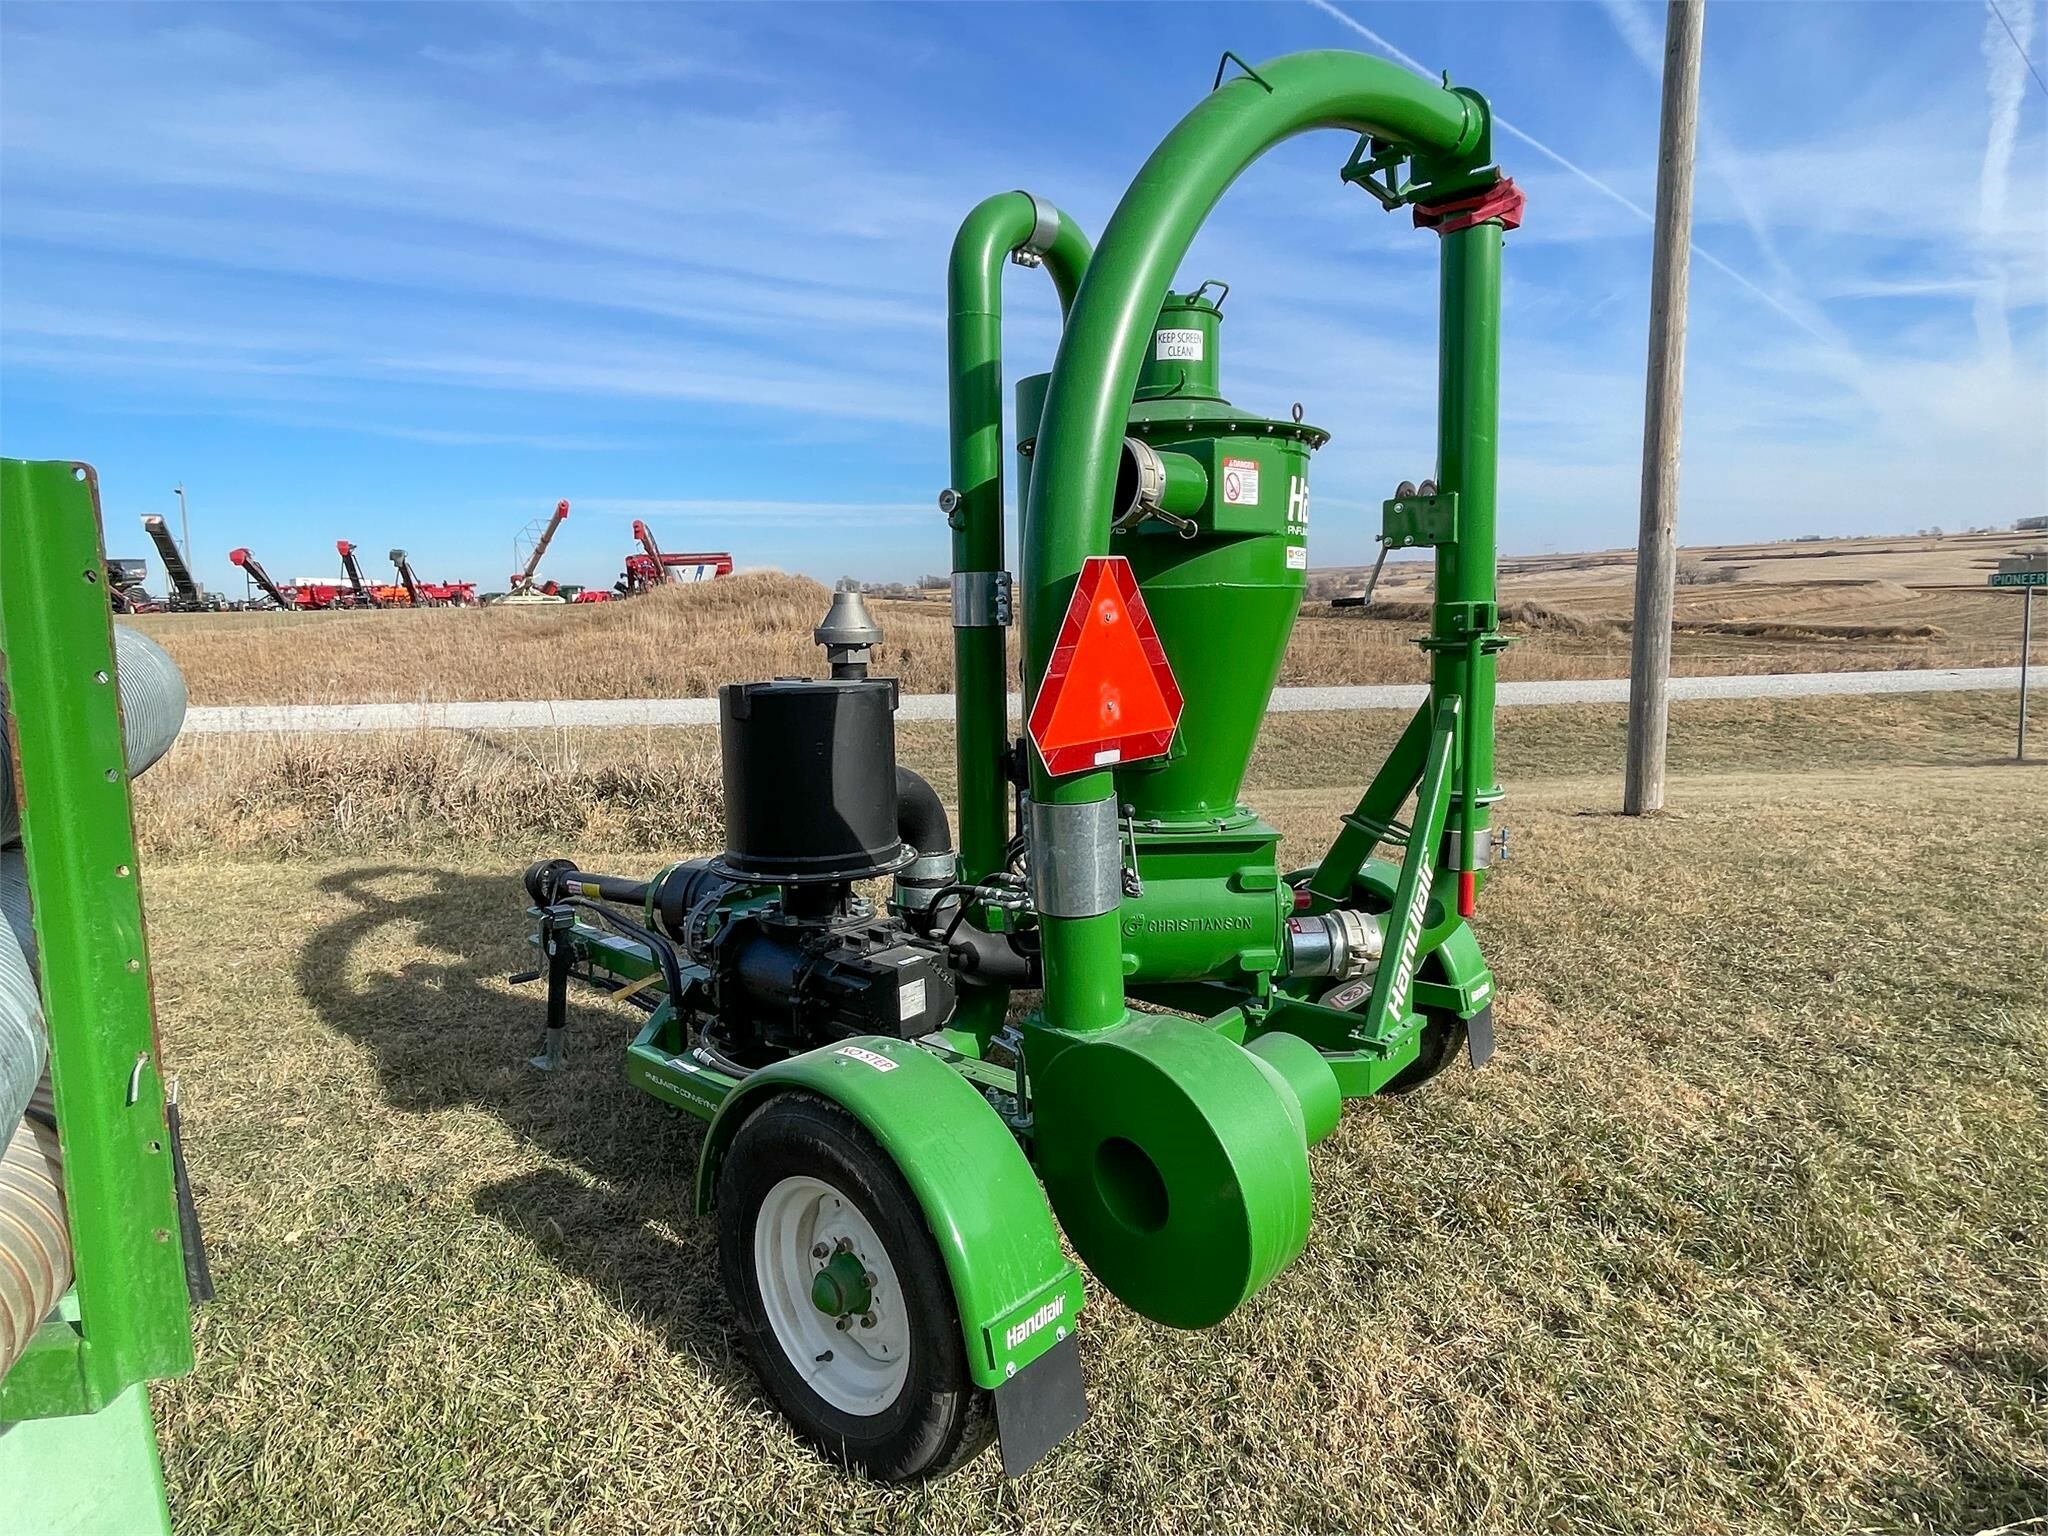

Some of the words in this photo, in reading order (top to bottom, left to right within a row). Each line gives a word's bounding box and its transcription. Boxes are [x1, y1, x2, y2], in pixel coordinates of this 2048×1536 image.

[1158, 332, 1176, 344] KEEP
[1177, 332, 1202, 344] SCREEN
[1993, 573, 2045, 584] PIONEER
[1147, 916, 1253, 933] CHRISTIANSON
[1388, 852, 1434, 1022] Handlair
[860, 1053, 893, 1068] STEP
[1006, 1295, 1066, 1351] Handlair
